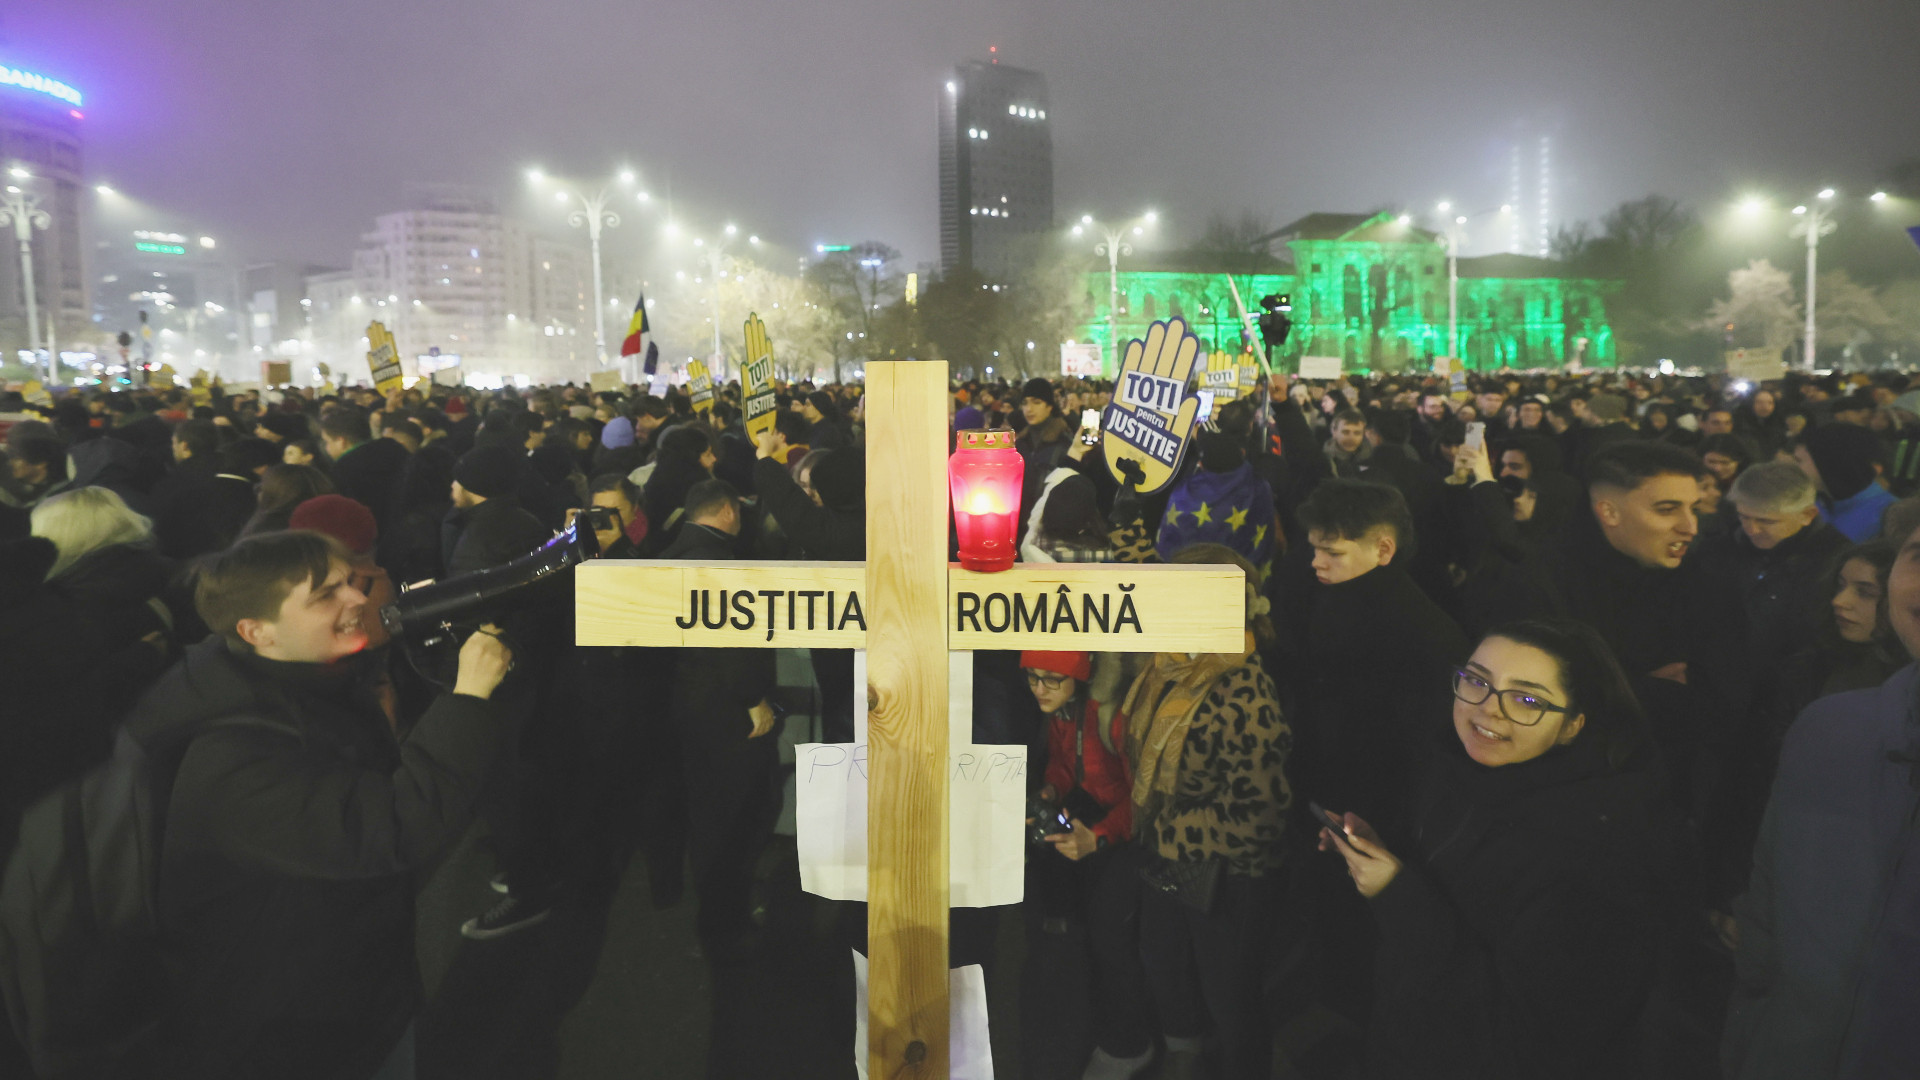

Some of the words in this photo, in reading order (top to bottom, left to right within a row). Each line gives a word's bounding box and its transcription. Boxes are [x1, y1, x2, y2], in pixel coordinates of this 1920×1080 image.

[1106, 408, 1178, 463] JUSTIȚIE
[1136, 407, 1165, 428] pentru
[675, 589, 867, 642] JUSȚITIA
[957, 583, 1143, 633] ROMÂNĂ
